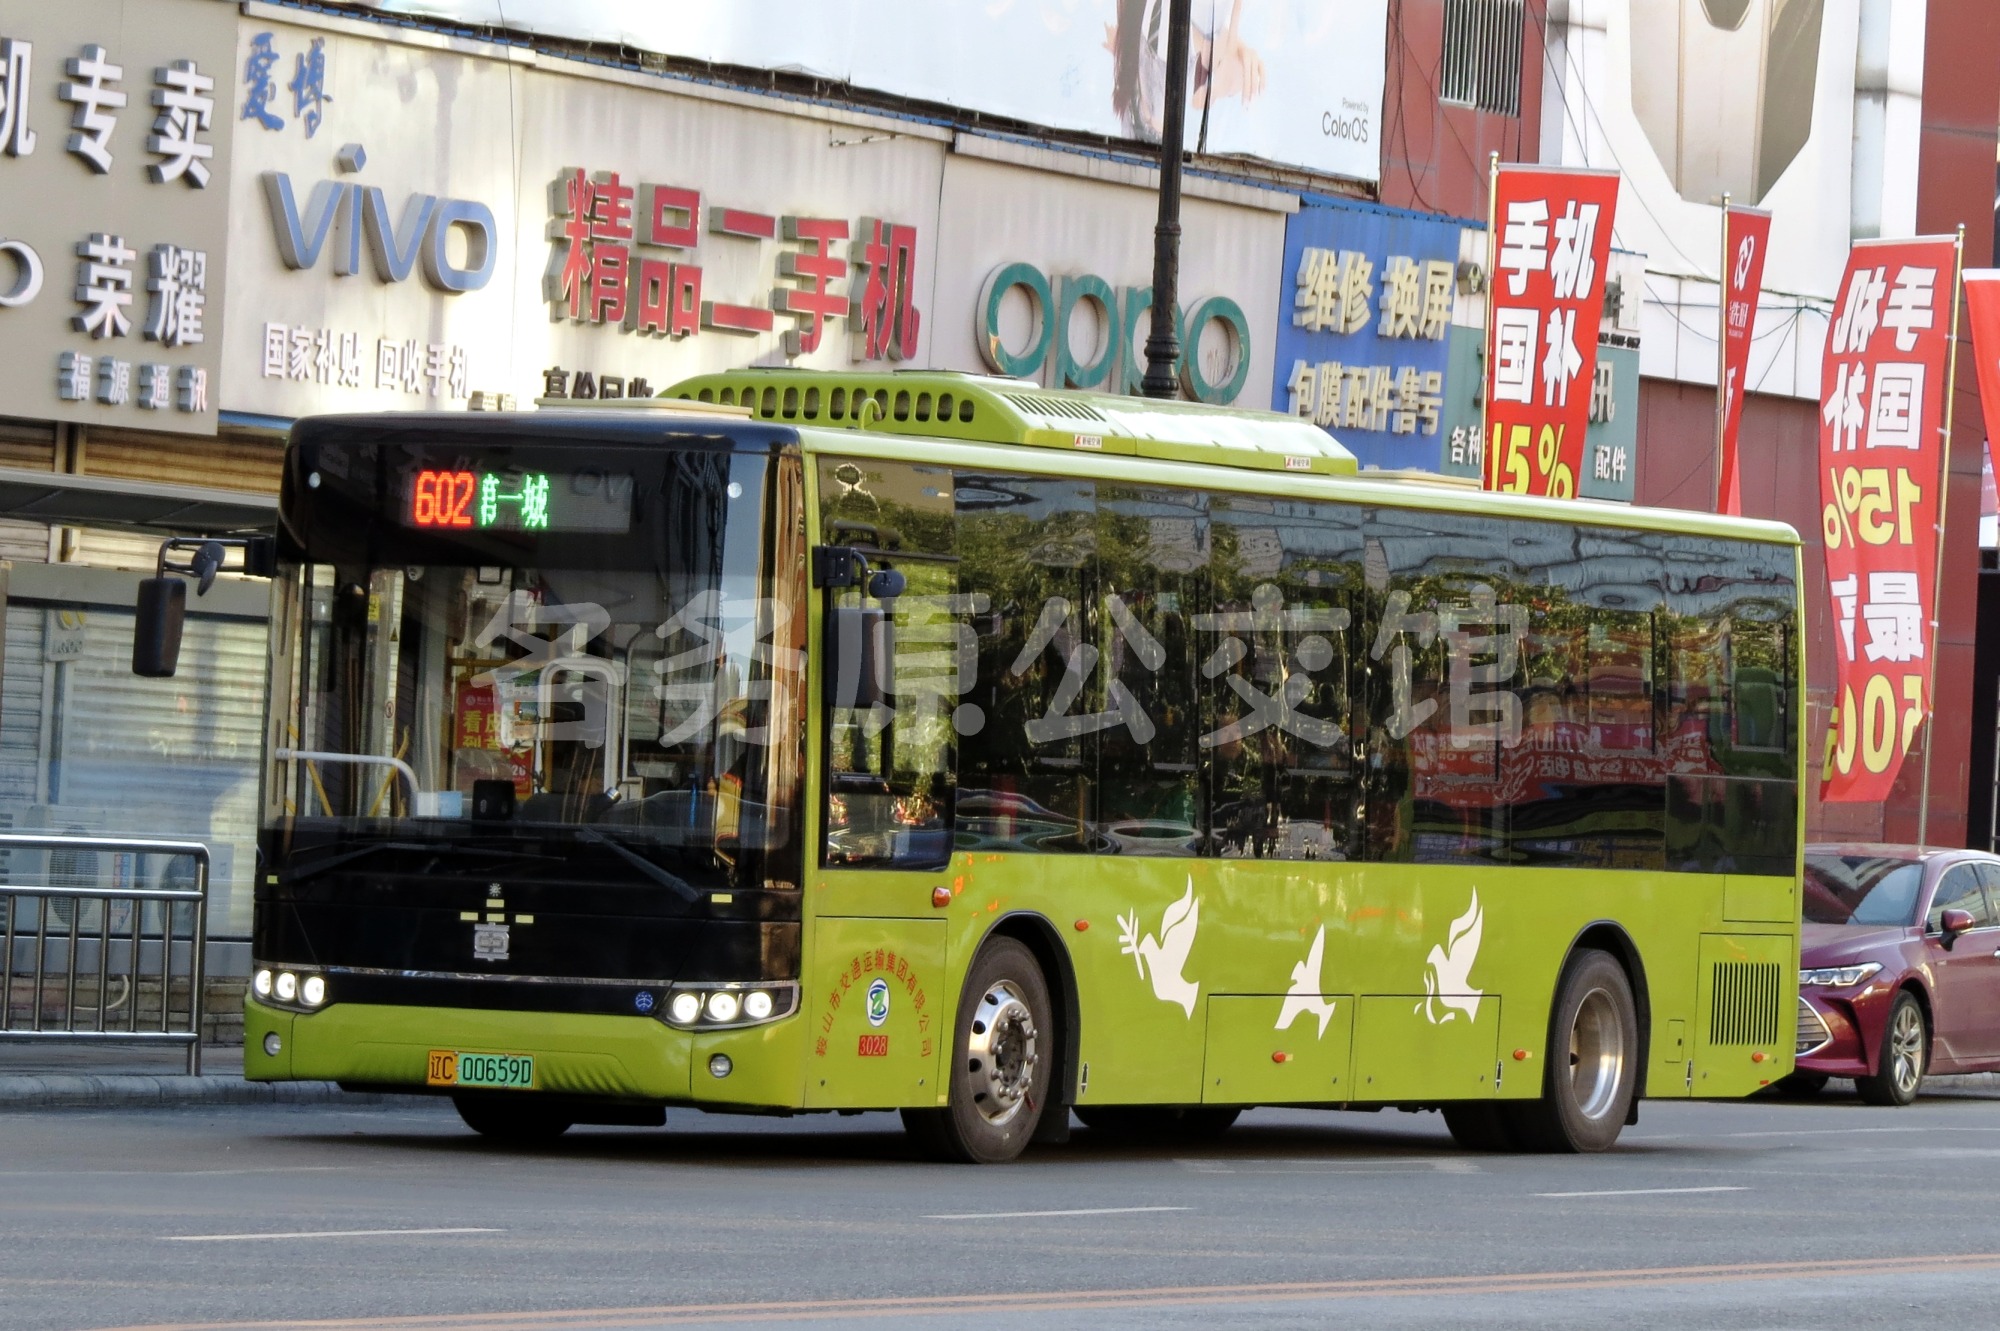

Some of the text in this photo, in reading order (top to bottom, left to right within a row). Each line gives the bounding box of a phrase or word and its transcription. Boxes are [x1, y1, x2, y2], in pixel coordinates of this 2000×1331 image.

[1322, 111, 1368, 143] ColorOS
[263, 143, 497, 293] vivo
[1500, 199, 1600, 300] 手机
[73, 232, 207, 348] 荣耀
[545, 167, 920, 363] 精品二手机
[1294, 247, 1454, 341] 维修 换屏
[263, 321, 470, 399] 国家补贴 回收手机
[976, 261, 1251, 406] oppo
[1493, 307, 1583, 407] 国补
[58, 351, 207, 412] 福源通讯
[1287, 360, 1443, 436] 包膜配件售号
[415, 471, 474, 525] 602
[1490, 421, 1577, 499] 15%
[1594, 445, 1628, 483] 配件
[462, 1056, 532, 1085] 00659D
[860, 1036, 887, 1055] 3028
